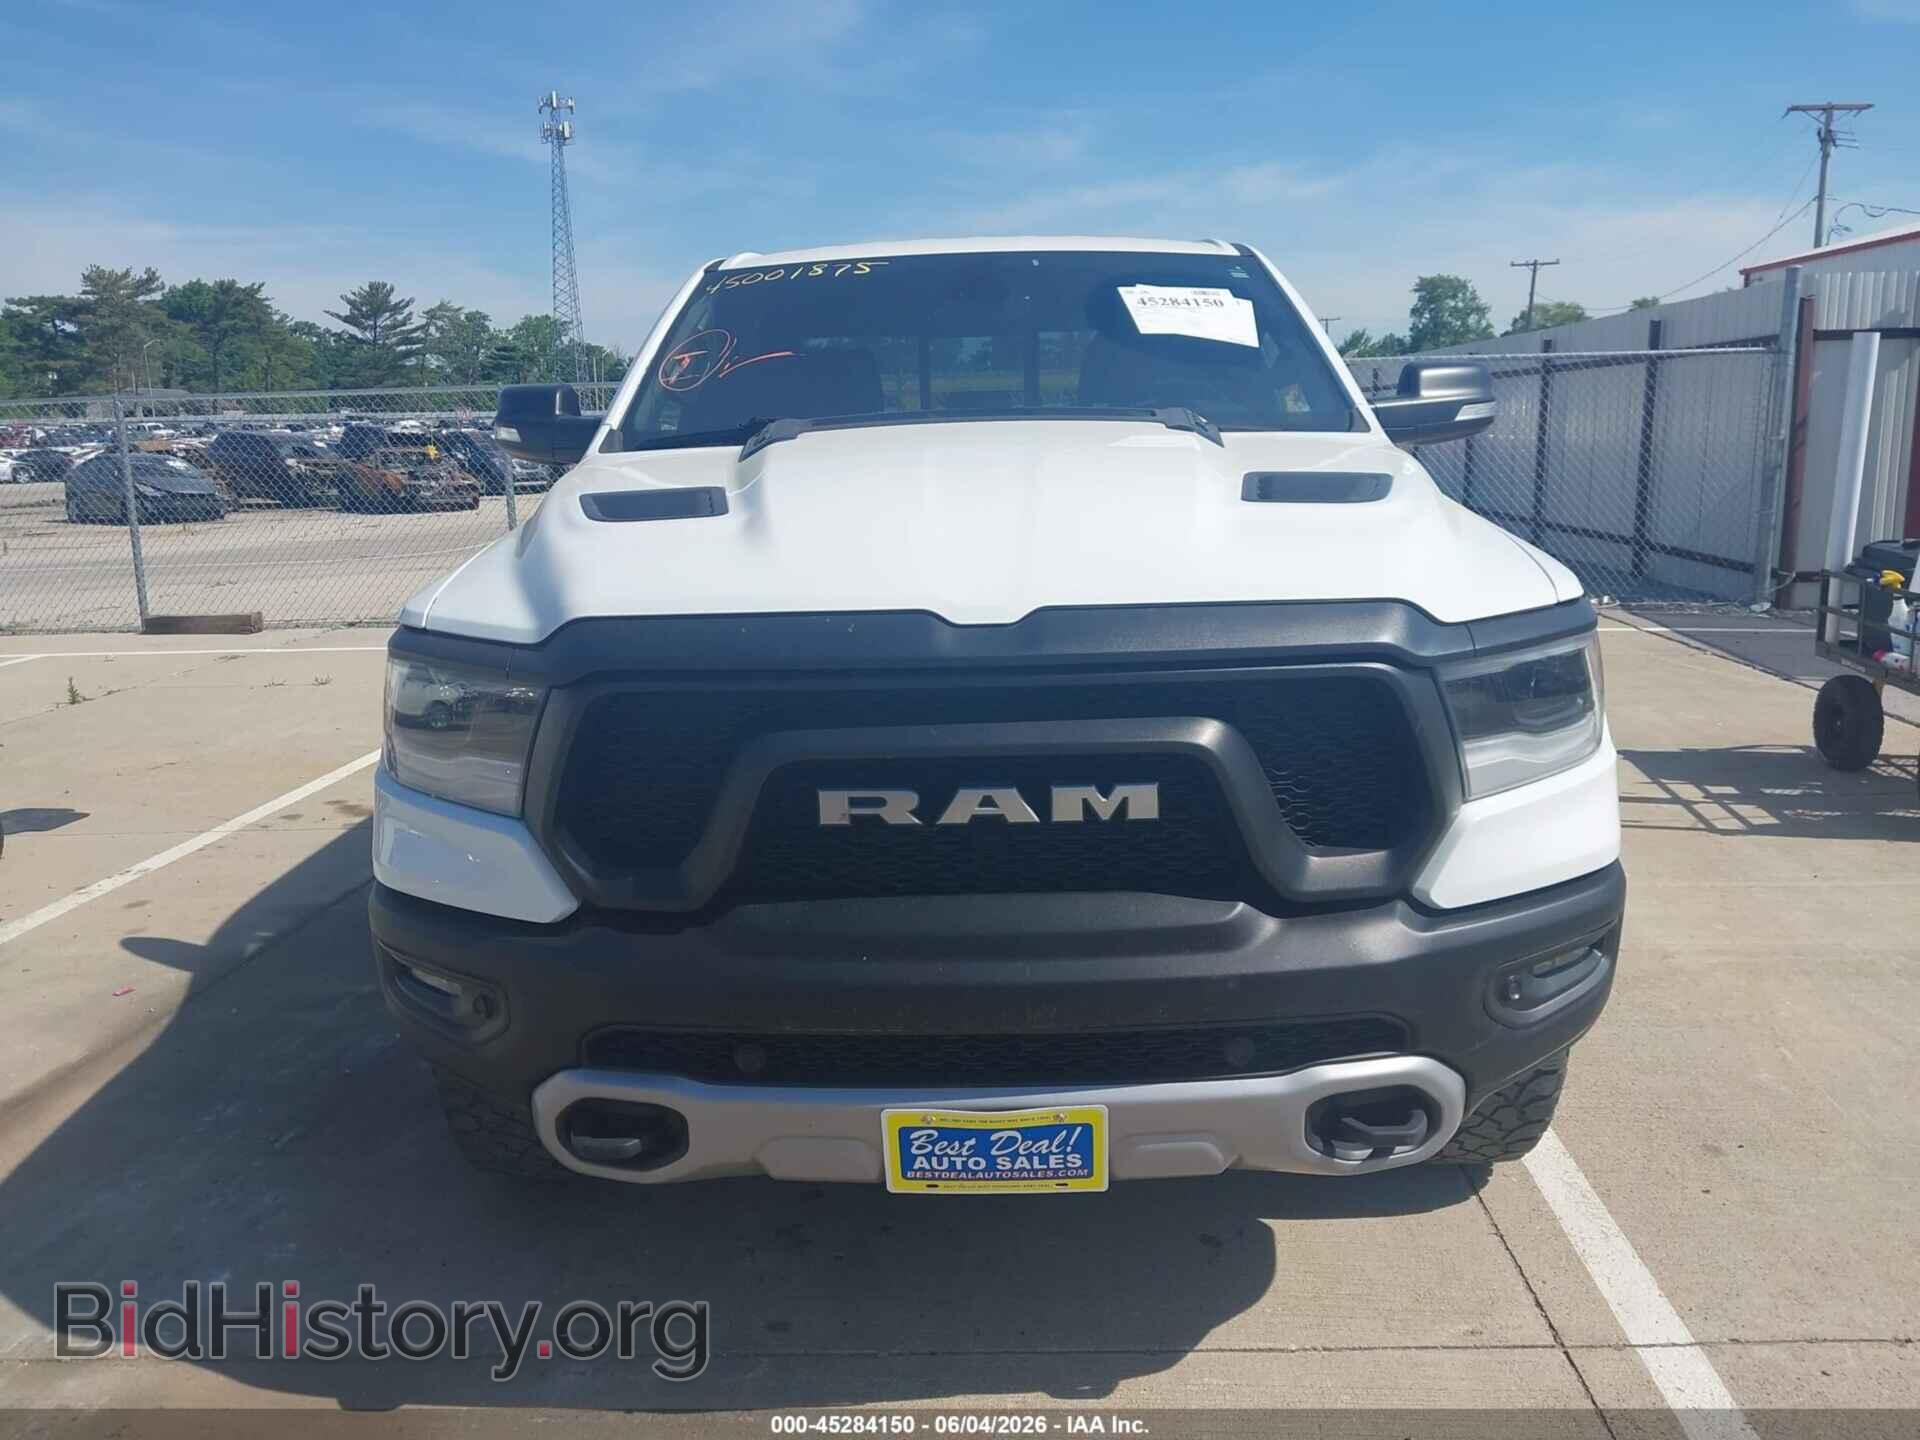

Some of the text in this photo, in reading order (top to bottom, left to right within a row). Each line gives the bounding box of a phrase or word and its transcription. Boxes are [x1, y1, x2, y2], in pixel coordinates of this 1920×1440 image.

[706, 262, 889, 294] 45001875
[1137, 296, 1225, 308] 45284150
[817, 782, 1159, 825] RAM
[909, 1126, 1083, 1156] Best Deal!
[913, 1153, 1082, 1170] AUTO SALES
[907, 1168, 1088, 1179] BESTDEALAUTOSALES.COM
